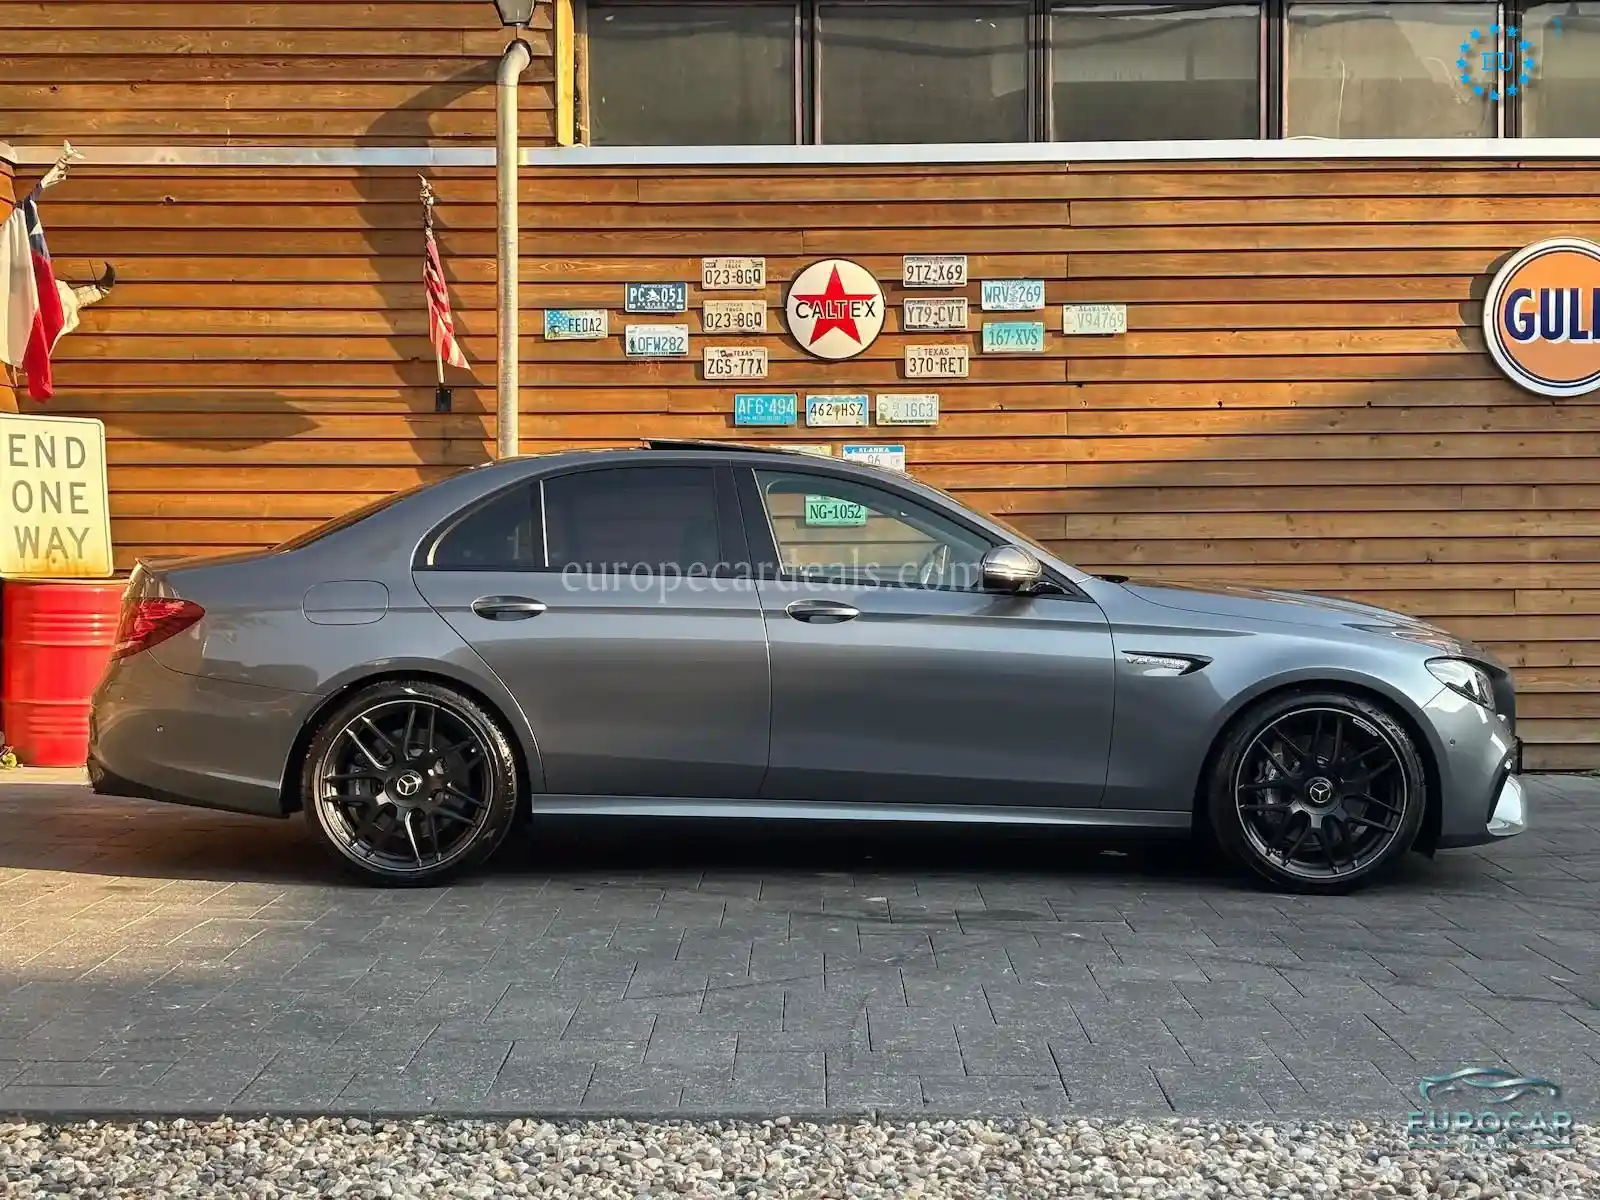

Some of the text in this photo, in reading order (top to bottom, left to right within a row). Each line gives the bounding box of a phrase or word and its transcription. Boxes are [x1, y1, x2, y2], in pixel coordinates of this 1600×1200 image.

[795, 301, 876, 319] CALTEX
[924, 348, 950, 356] TEXAS
[8, 433, 86, 469] END
[12, 480, 90, 514] ONE
[810, 504, 862, 519] NG-1052
[14, 525, 91, 560] WAY
